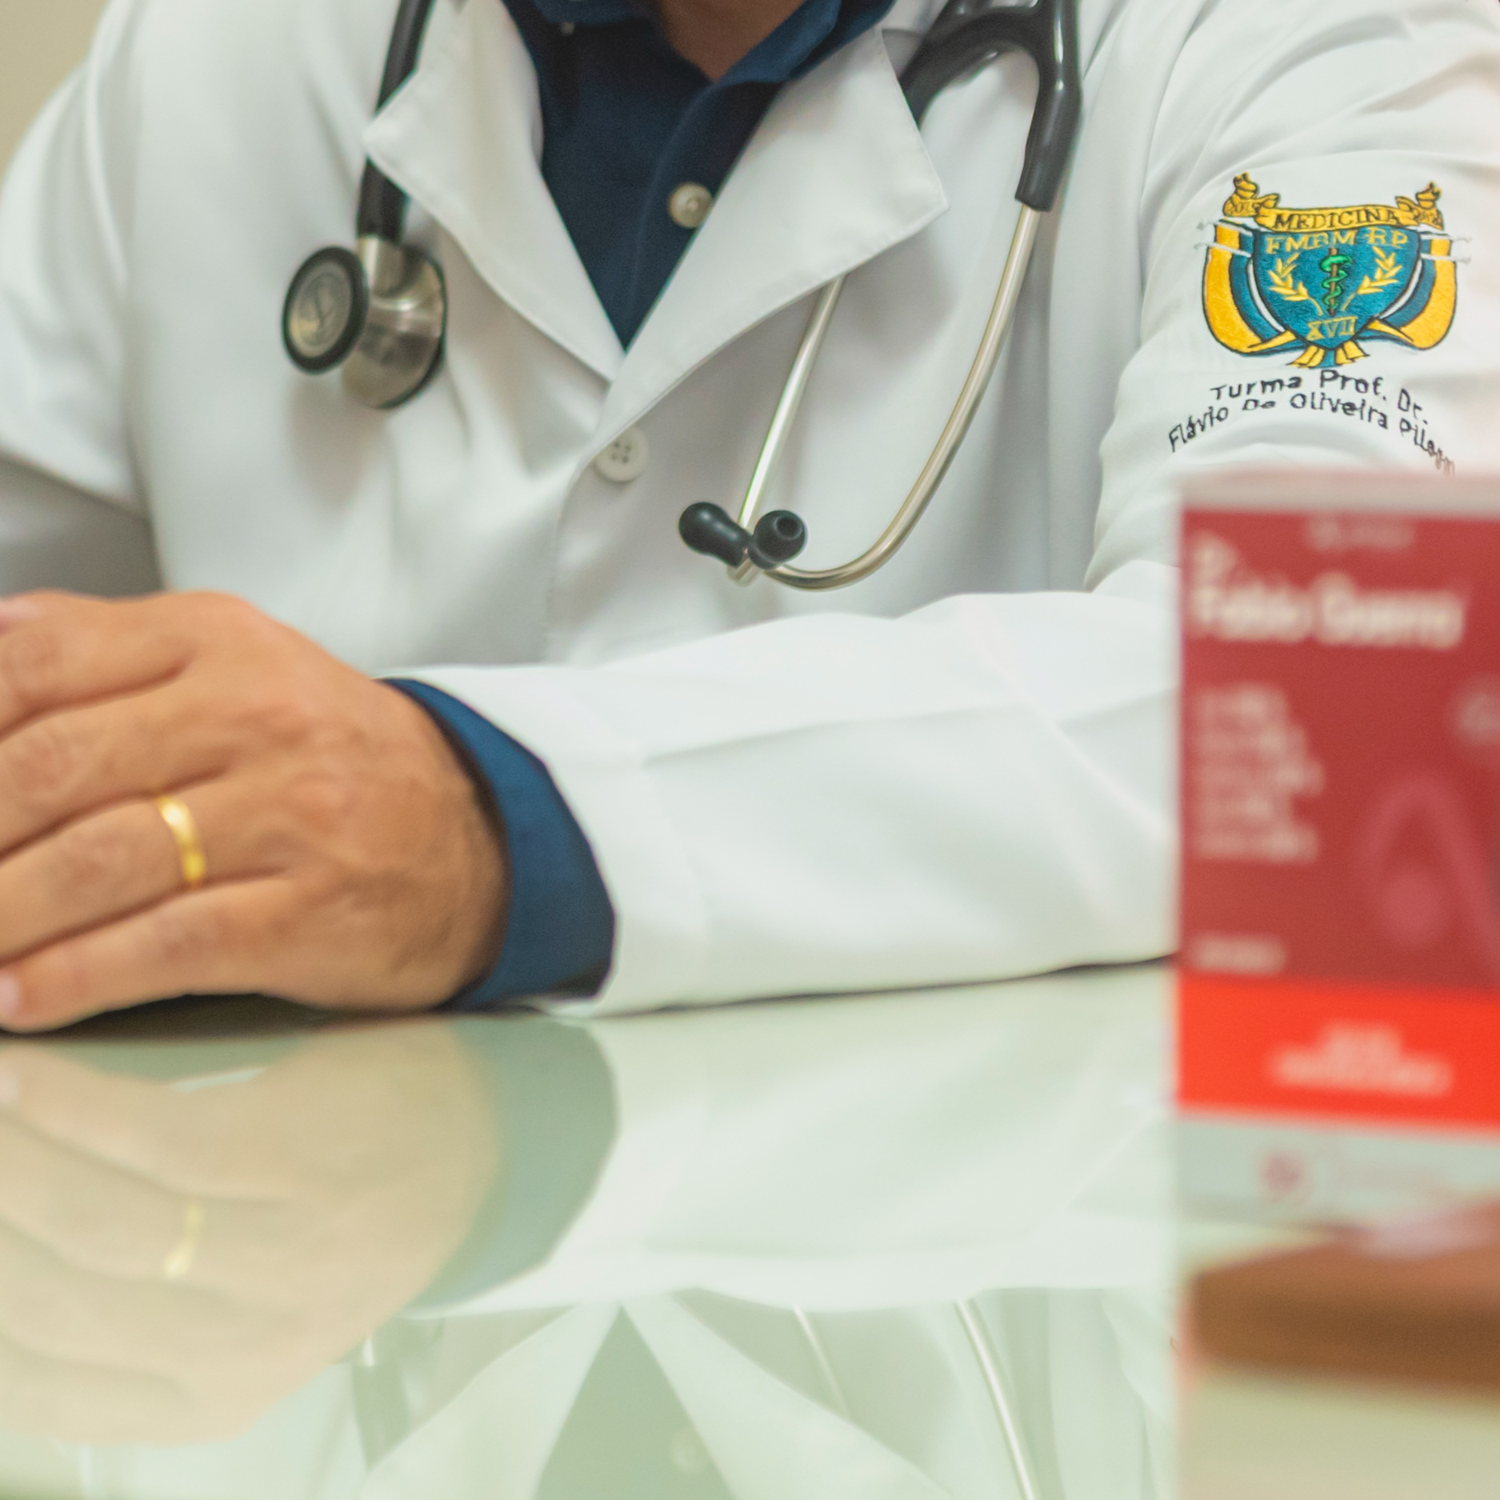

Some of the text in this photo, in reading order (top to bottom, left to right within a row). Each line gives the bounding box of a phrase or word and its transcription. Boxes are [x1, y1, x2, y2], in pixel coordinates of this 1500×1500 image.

[1274, 208, 1398, 229] MEDICINA
[1306, 315, 1358, 341] XVII
[1209, 369, 1429, 426] Turma Prof. Dr.
[1289, 391, 1389, 430] Oliveira
